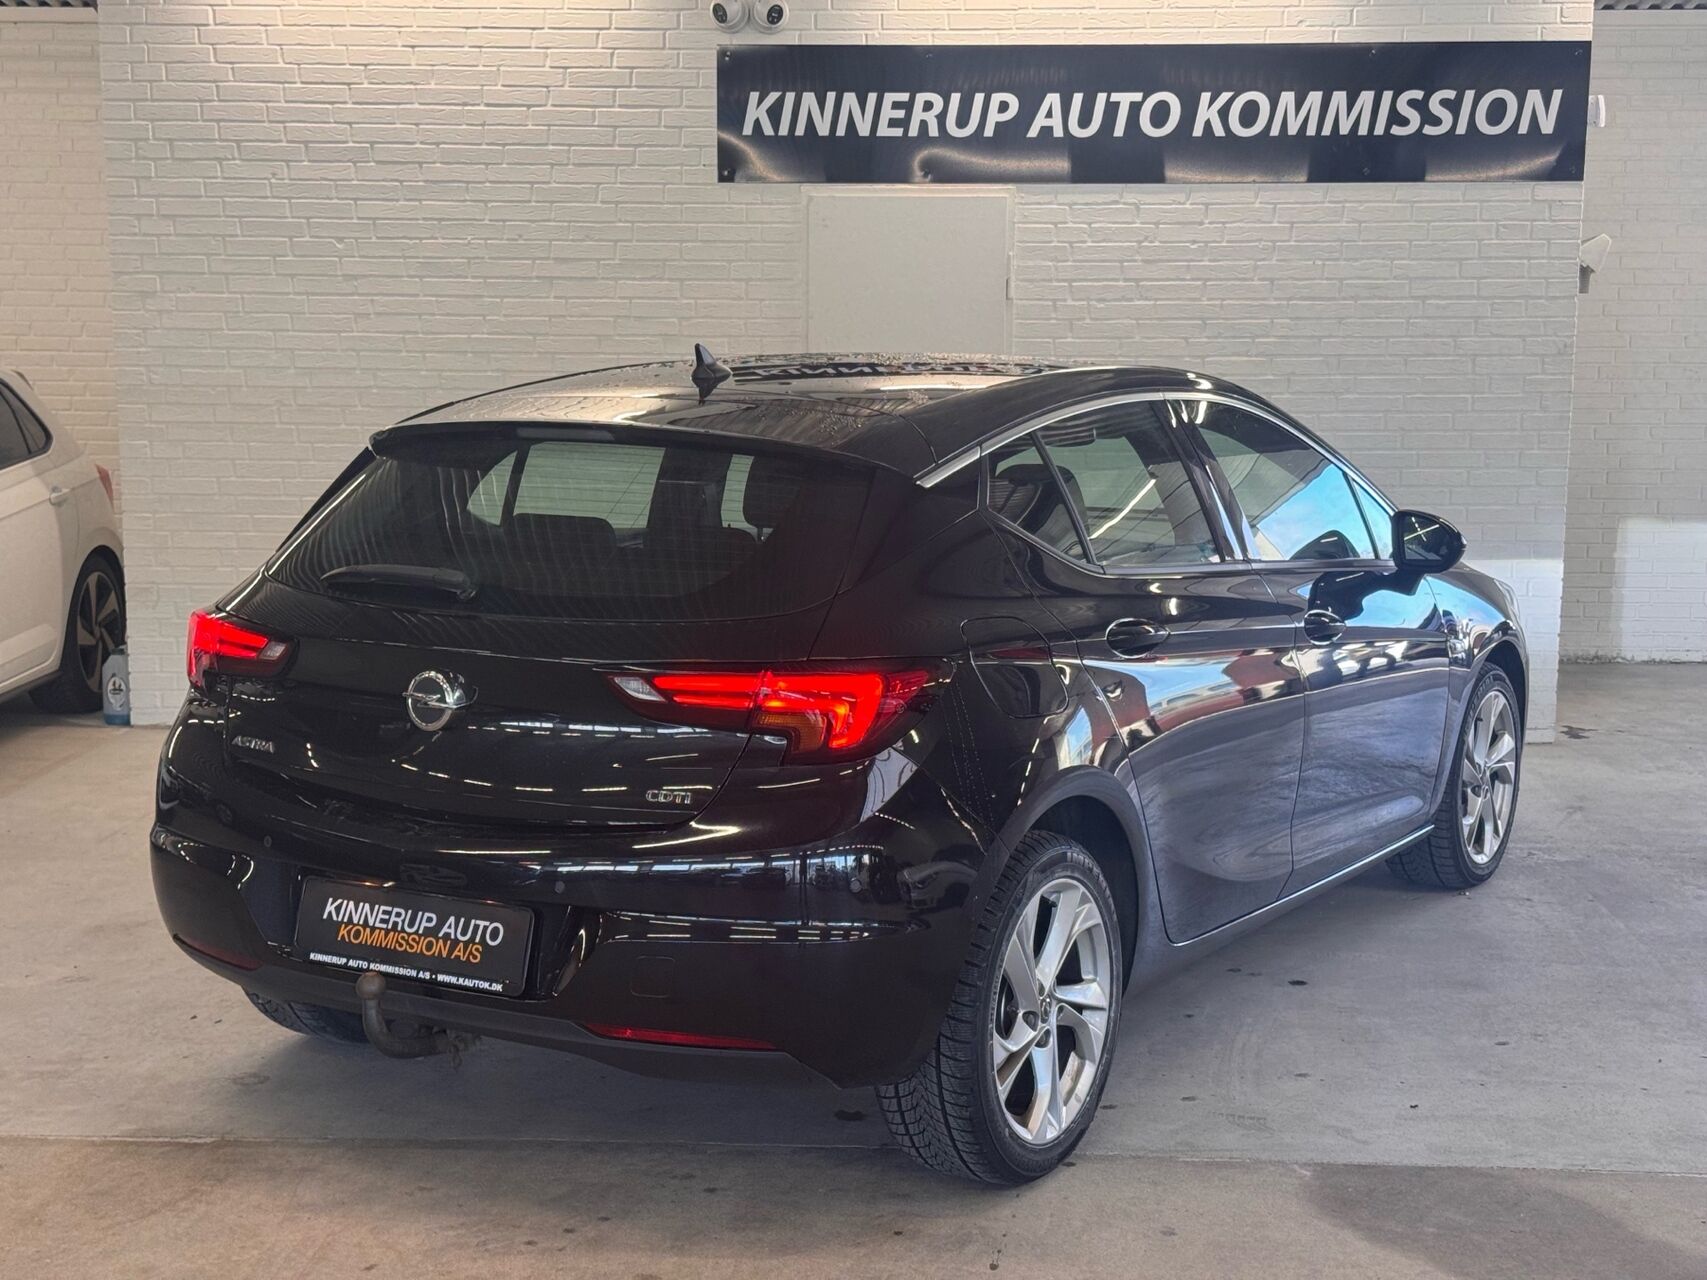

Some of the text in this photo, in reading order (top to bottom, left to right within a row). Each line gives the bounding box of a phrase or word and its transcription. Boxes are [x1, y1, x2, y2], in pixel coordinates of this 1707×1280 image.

[742, 88, 1563, 138] KINNERUP AUTO KOMMISSION
[232, 735, 275, 753] ASTRA
[322, 897, 504, 947] KINNERUP AUTO
[337, 923, 482, 964] KOMMISSION A/S
[309, 952, 504, 992] KINNERUP AUTO KOMMISSION A/S WWW.KAUTOK.DK
